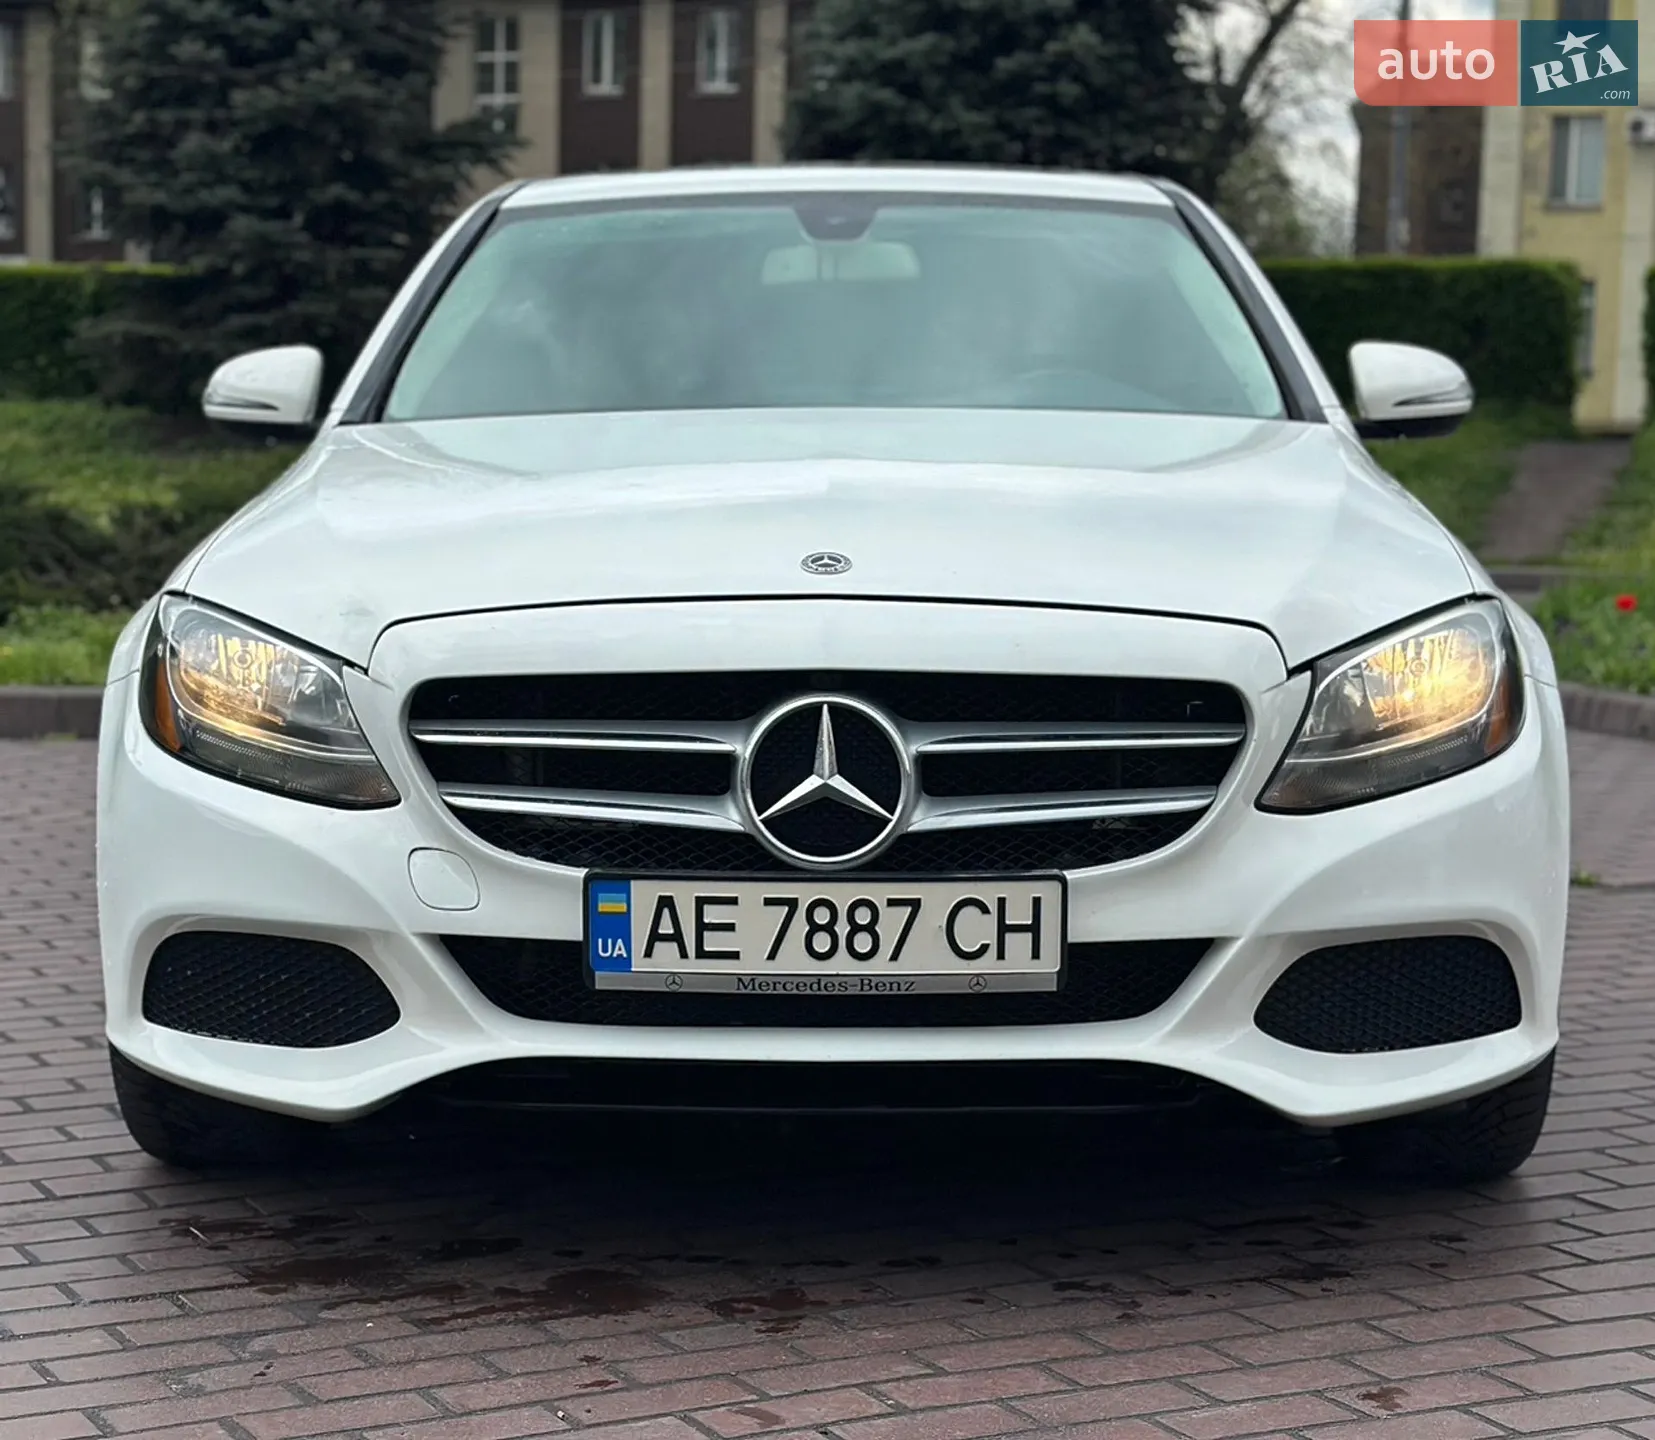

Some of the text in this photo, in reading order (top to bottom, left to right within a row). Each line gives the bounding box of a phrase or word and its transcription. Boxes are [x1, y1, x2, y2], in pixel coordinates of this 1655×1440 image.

[642, 894, 1042, 962] AE 7887 CH
[597, 938, 627, 958] UA
[736, 976, 916, 993] Mercedes-Benz
